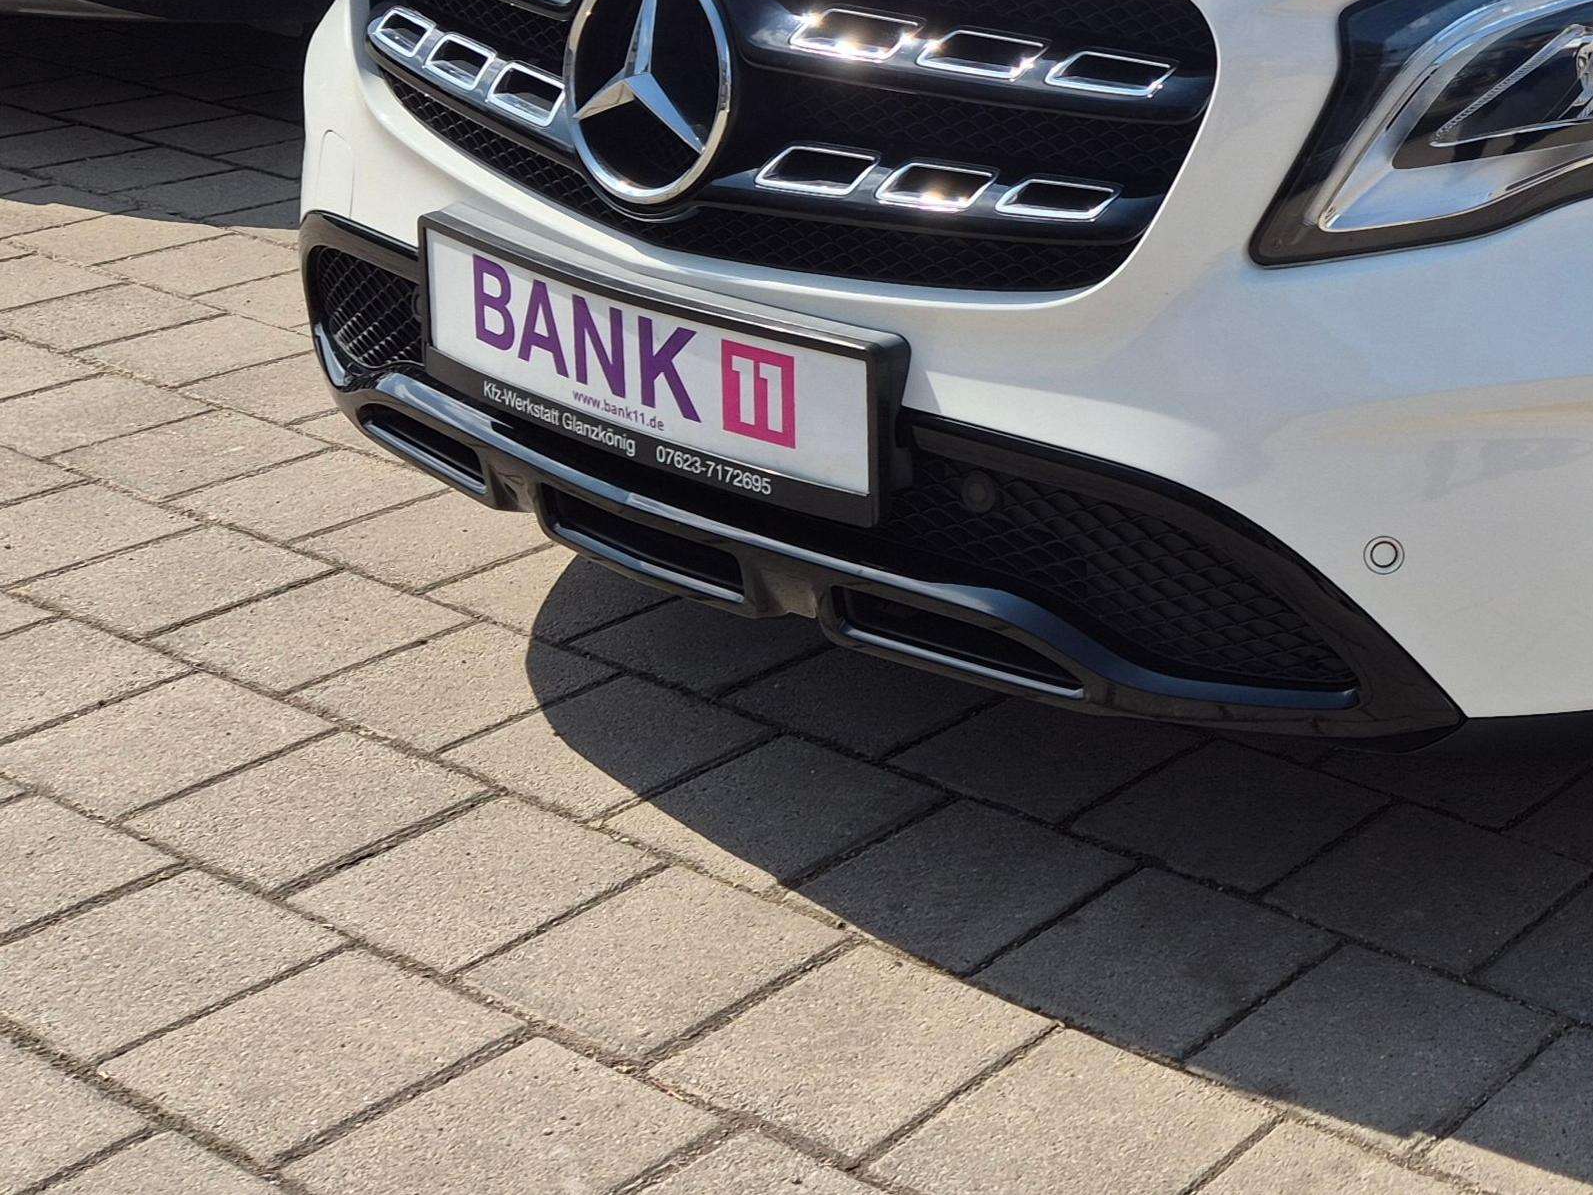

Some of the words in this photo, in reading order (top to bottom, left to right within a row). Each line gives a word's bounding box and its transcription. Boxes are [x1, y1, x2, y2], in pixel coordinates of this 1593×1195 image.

[472, 254, 701, 423] BANK
[732, 355, 783, 433] 11
[483, 380, 560, 426] Kfz-Werkstatt
[561, 412, 636, 457] Glanzkönig
[656, 445, 772, 495] 07623-7172695
[572, 389, 665, 431] www.bank11.de
